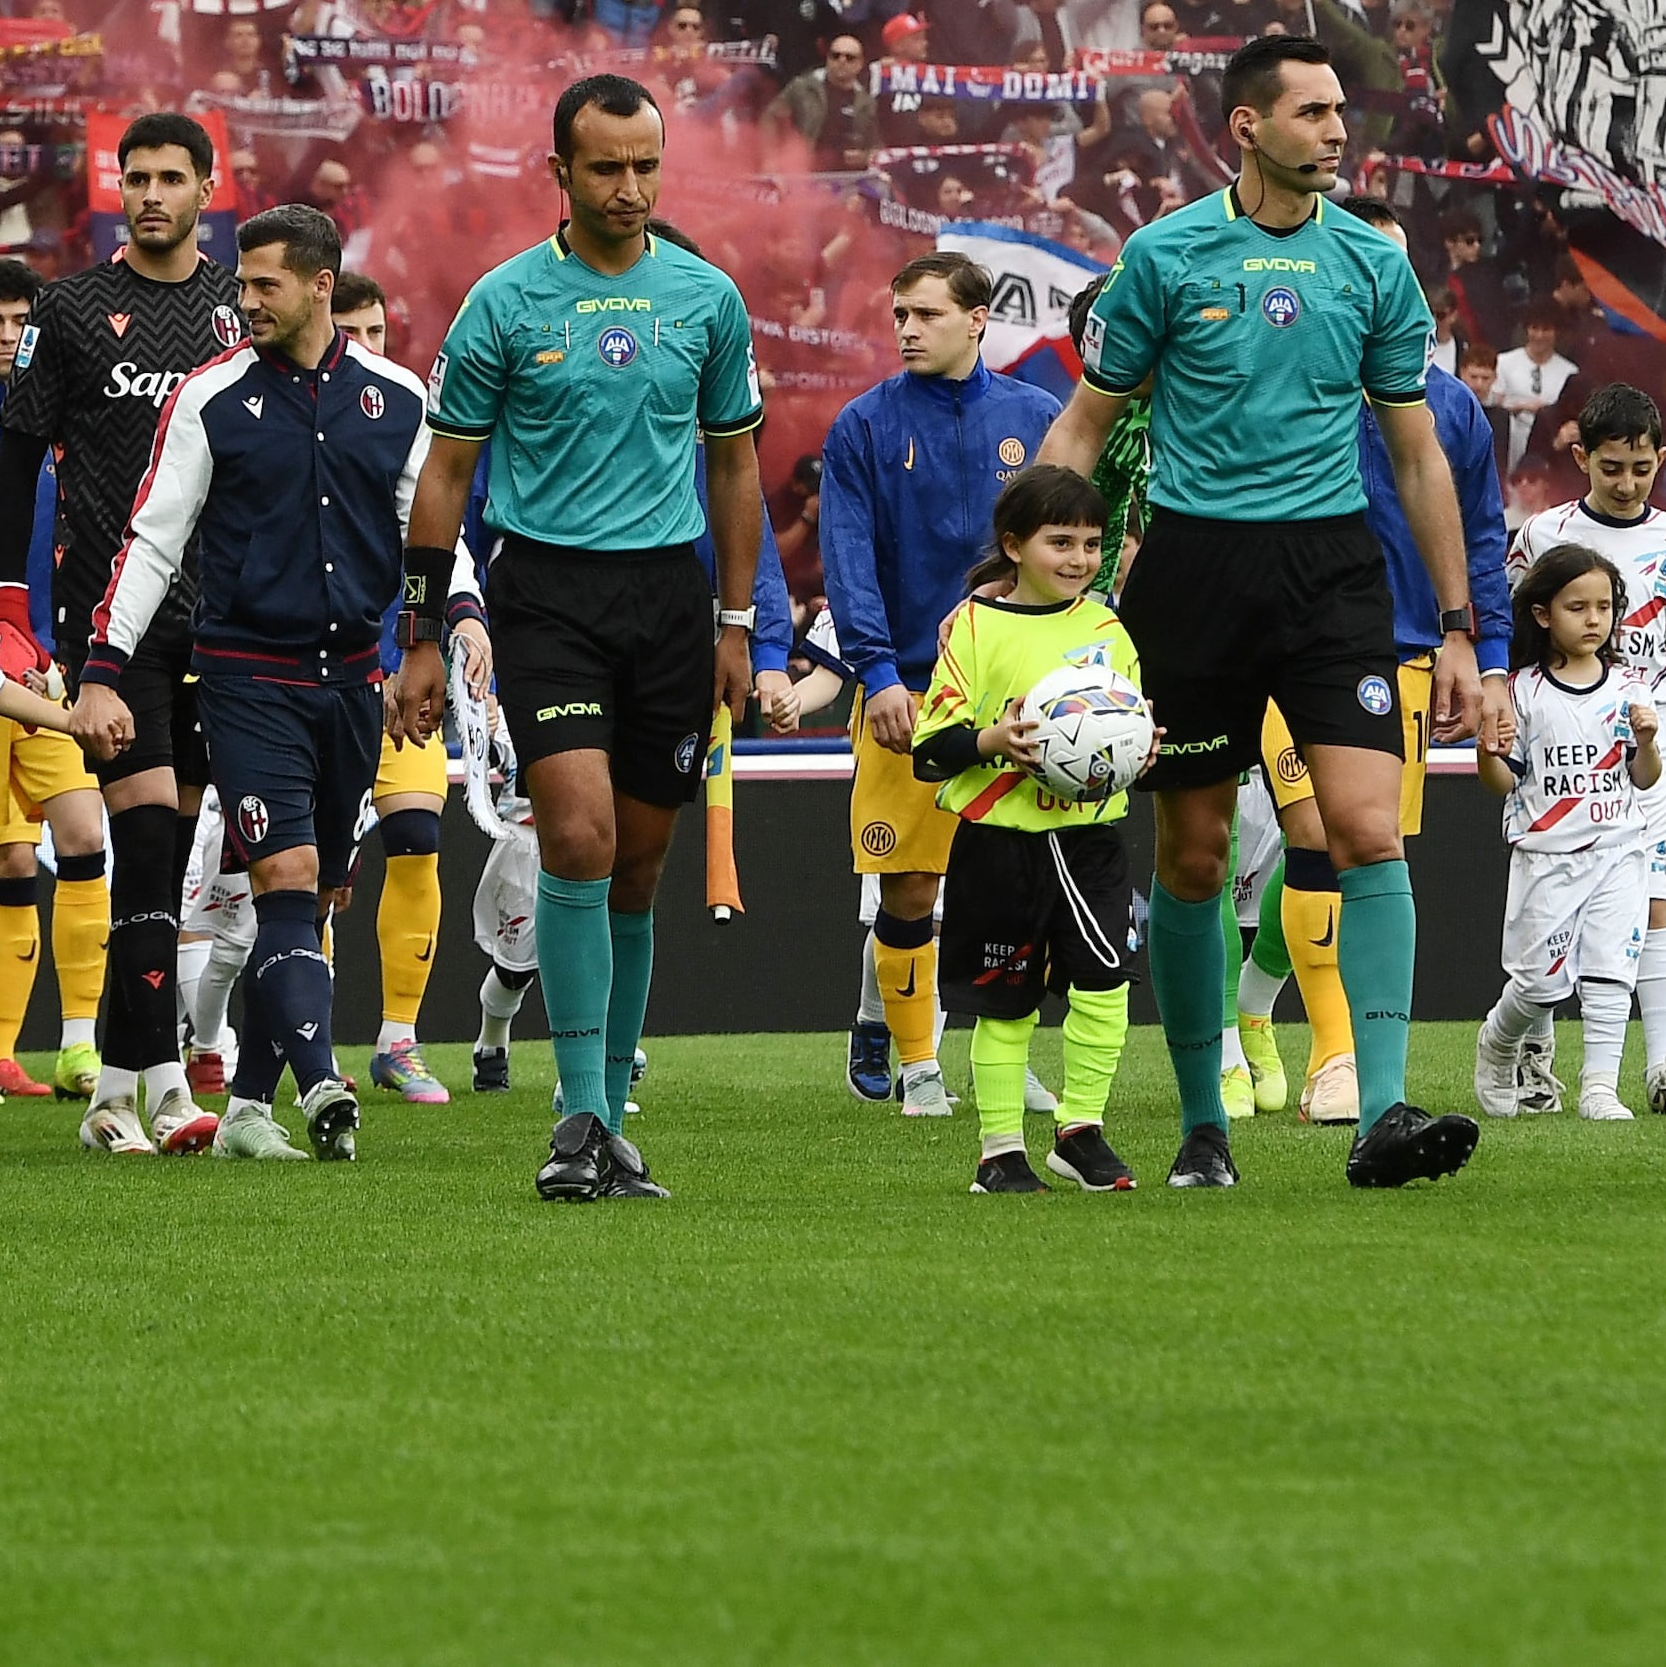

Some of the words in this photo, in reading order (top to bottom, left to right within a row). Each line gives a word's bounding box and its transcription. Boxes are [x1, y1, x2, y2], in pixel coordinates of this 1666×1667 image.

[890, 66, 957, 97] MAI
[1001, 66, 1093, 101] DOMI
[1243, 257, 1316, 275] GIVOVA
[576, 297, 651, 314] GIVOVA
[537, 701, 602, 721] GIVOVA
[1159, 735, 1229, 755] GIVOVA
[1543, 744, 1599, 769] KEEP
[1542, 773, 1623, 797] RACISM
